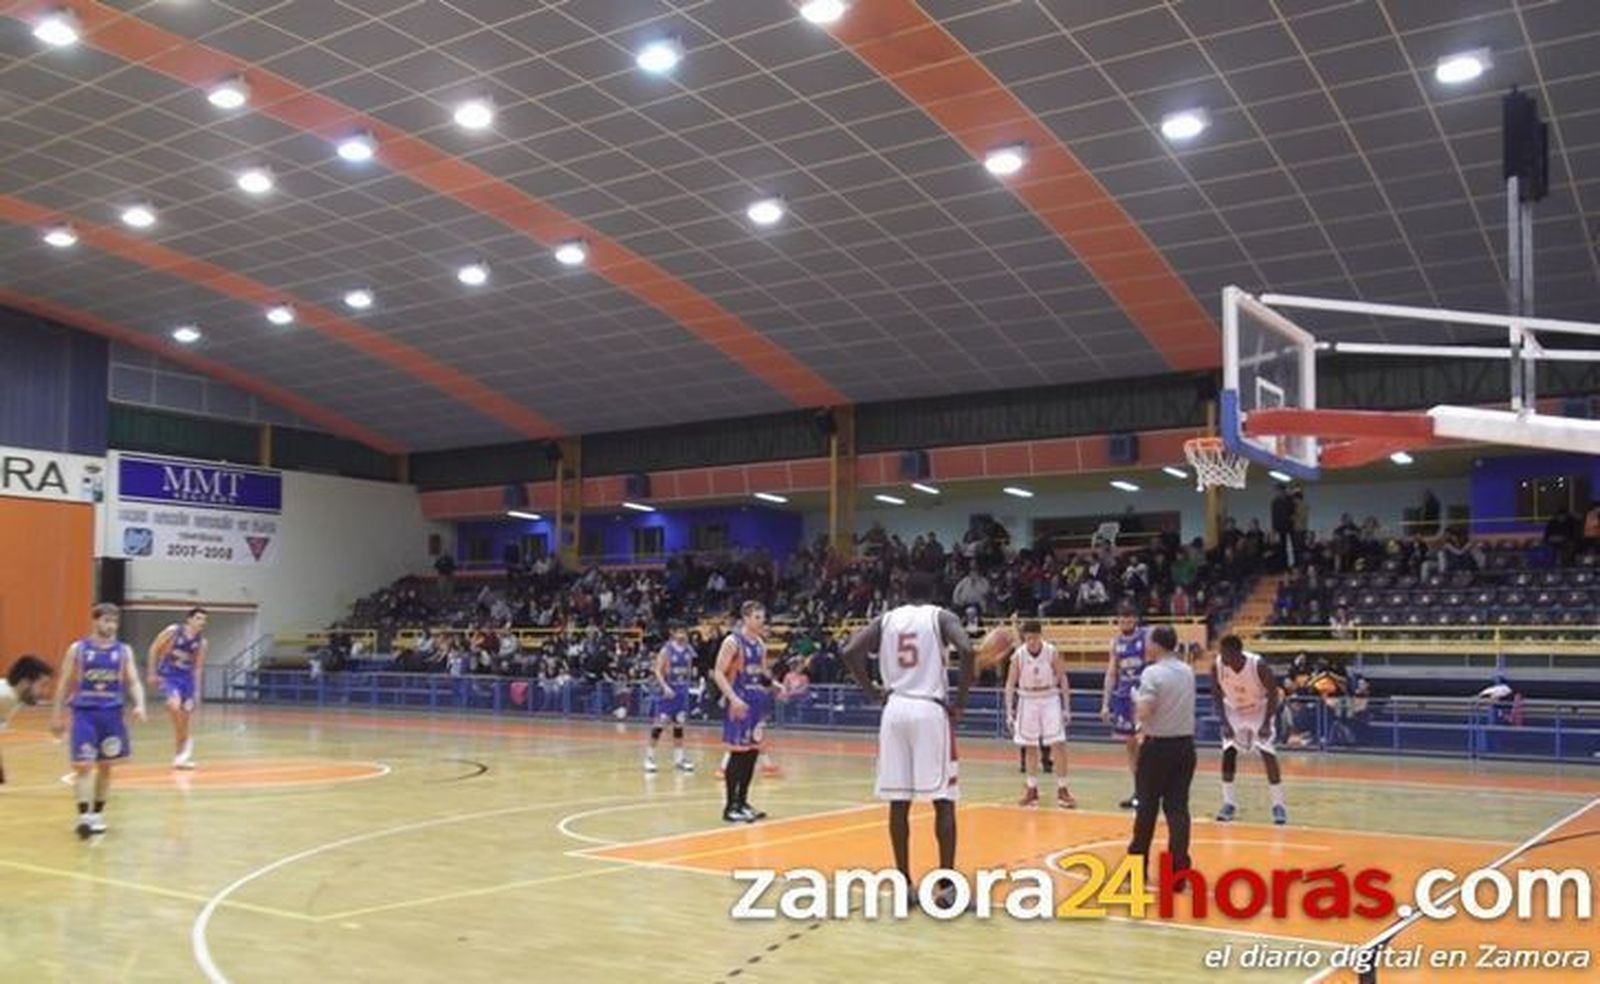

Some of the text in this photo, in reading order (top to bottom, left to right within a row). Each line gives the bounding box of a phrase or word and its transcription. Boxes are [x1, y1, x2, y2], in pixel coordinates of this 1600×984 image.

[3, 456, 68, 494] RA
[162, 465, 245, 497] MMT
[898, 633, 918, 668] 5
